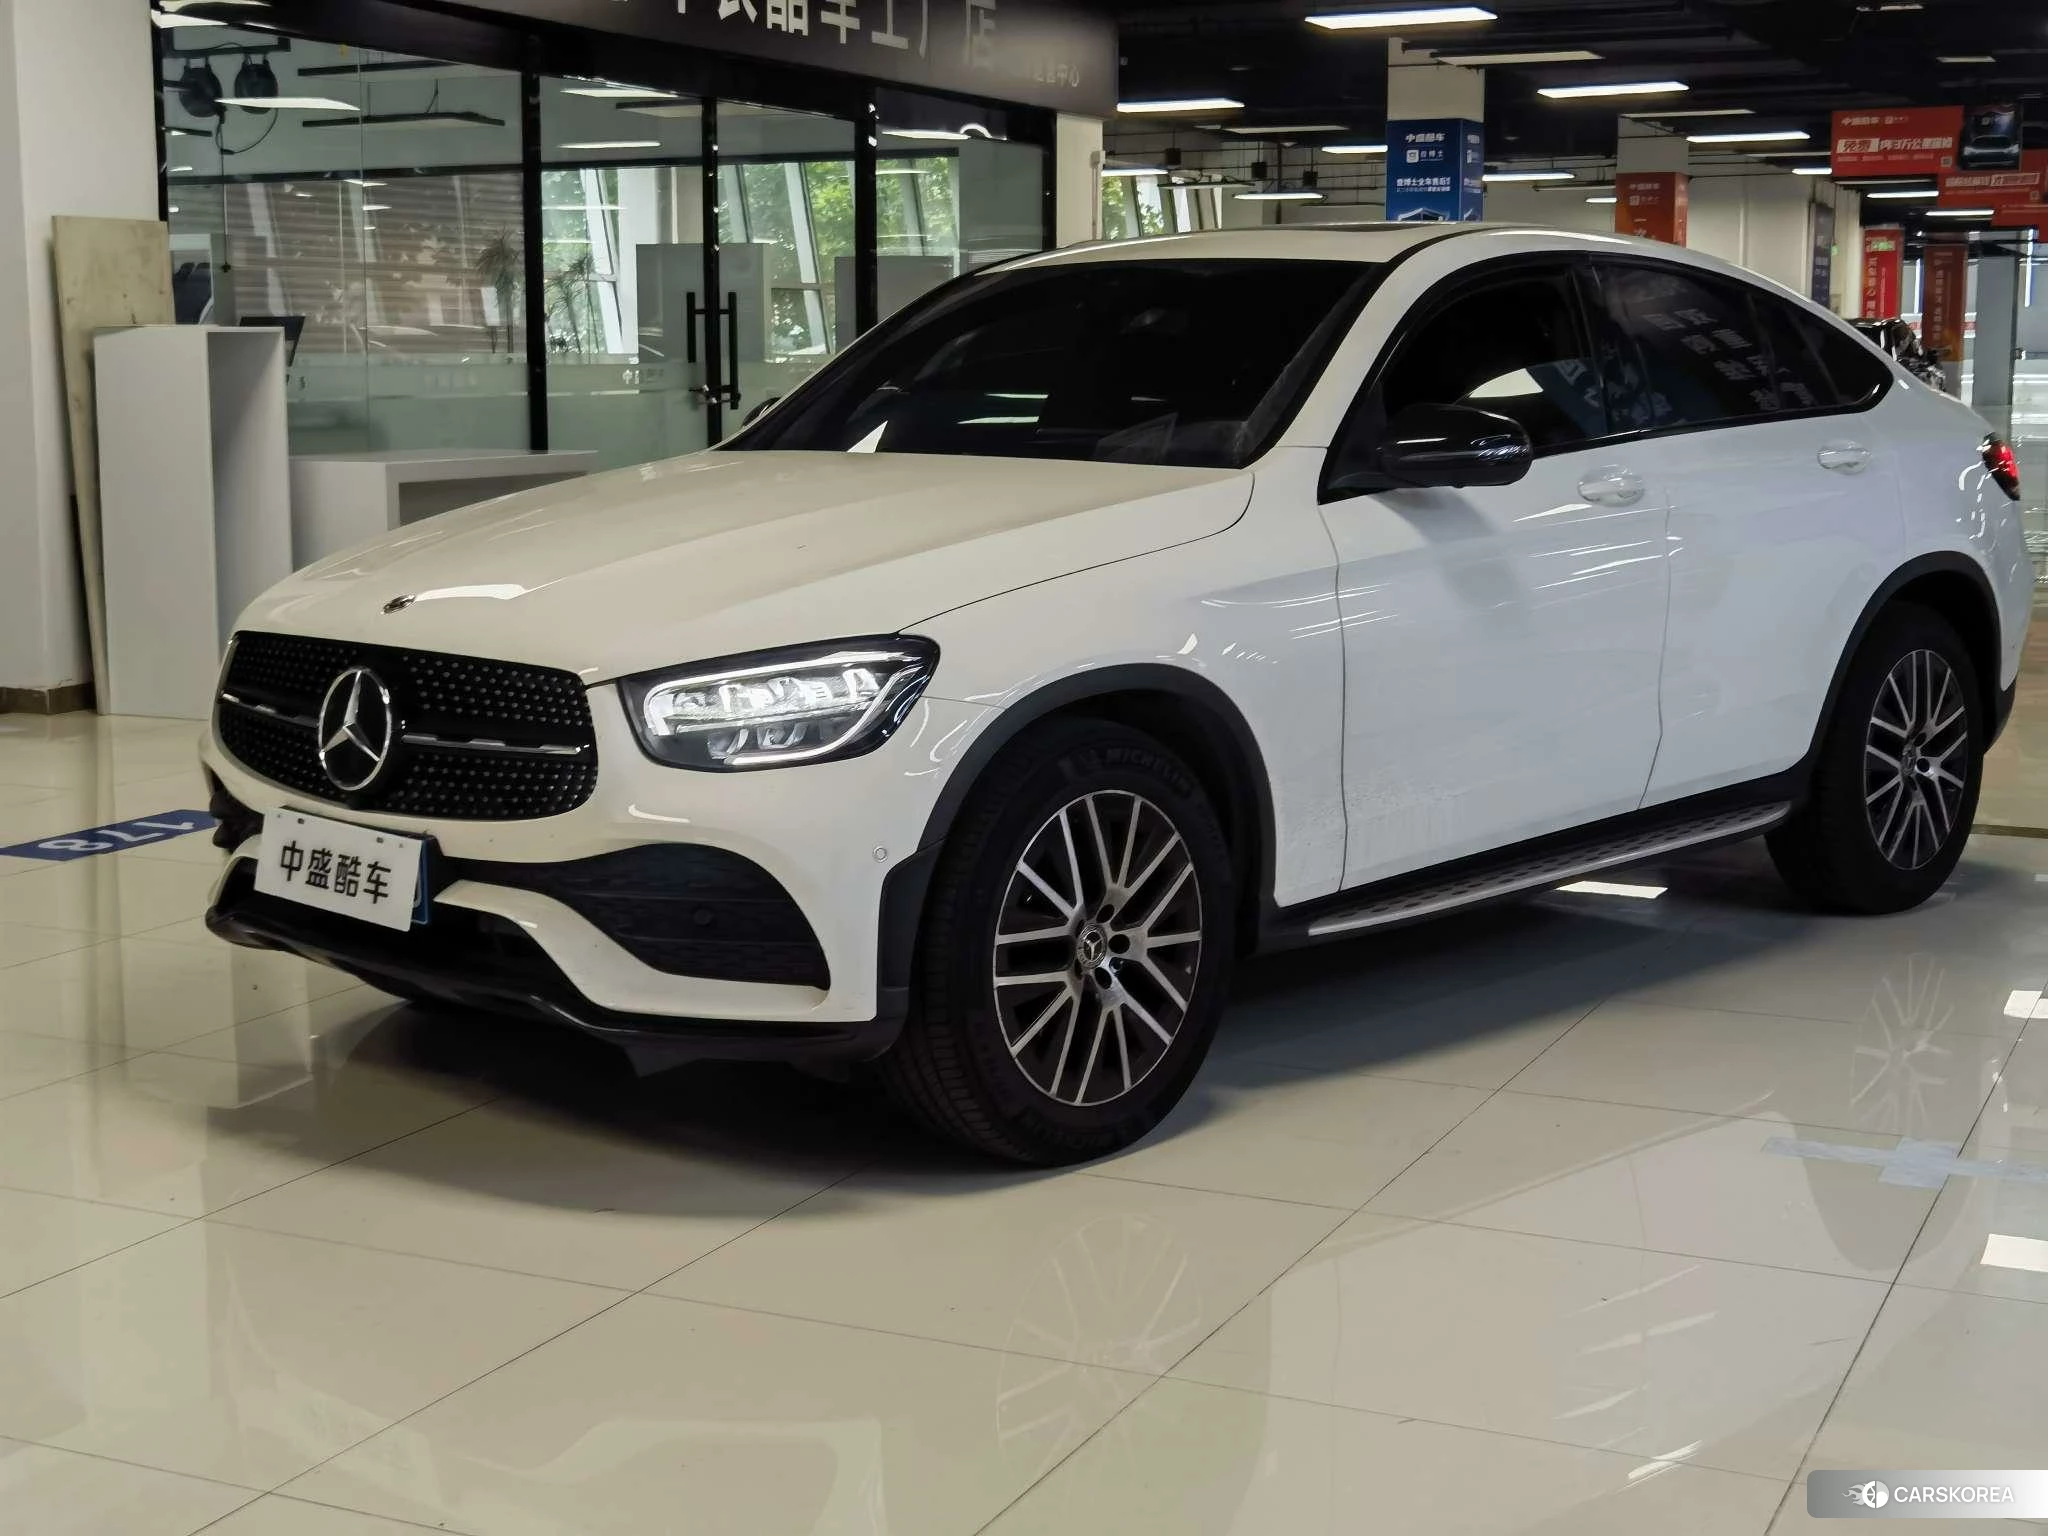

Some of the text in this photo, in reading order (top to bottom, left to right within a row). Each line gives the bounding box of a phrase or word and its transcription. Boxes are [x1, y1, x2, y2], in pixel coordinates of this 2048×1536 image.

[38, 821, 194, 853] 178
[280, 840, 392, 905] 中盛酷车
